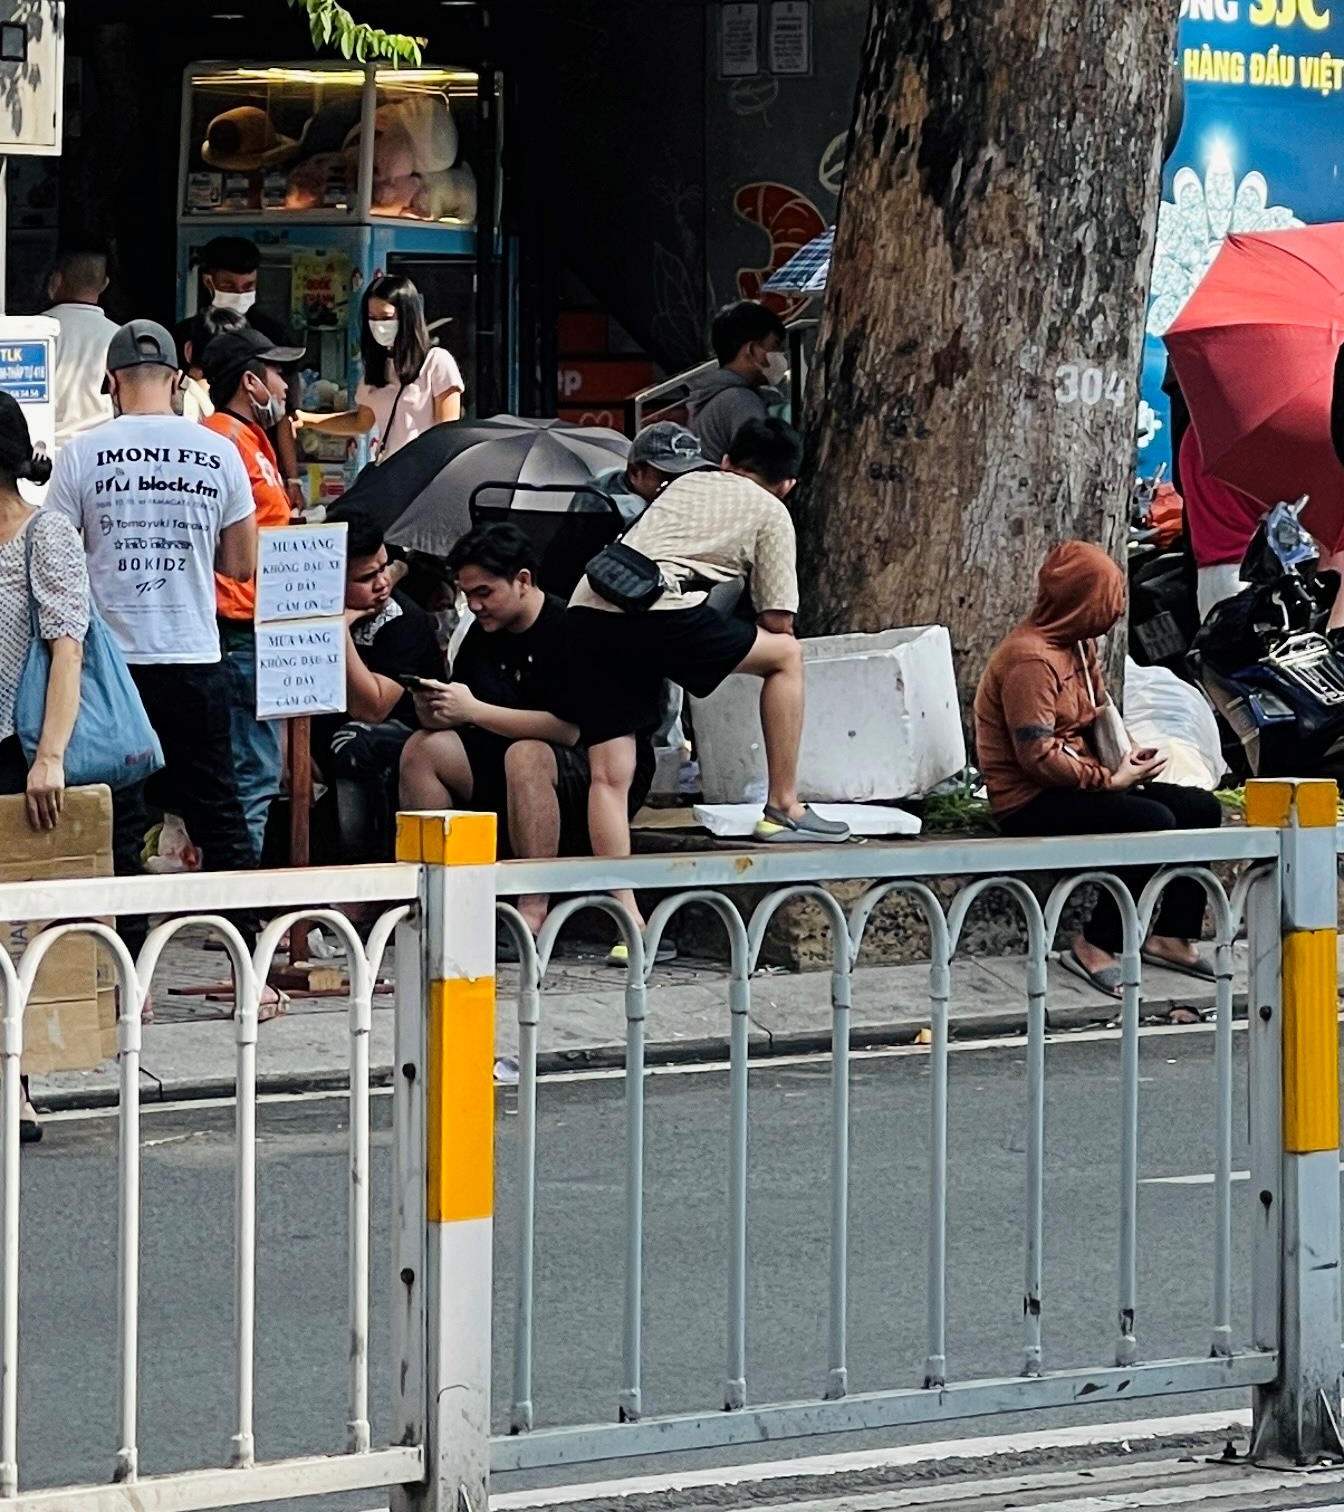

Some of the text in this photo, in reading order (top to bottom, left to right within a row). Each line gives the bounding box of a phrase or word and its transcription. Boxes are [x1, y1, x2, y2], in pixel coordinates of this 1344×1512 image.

[1183, 43, 1246, 84] HÀNG
[0, 348, 23, 362] TLK
[1055, 363, 1126, 408] 304
[96, 447, 221, 470] IMONI FES
[138, 475, 219, 499] block.fm
